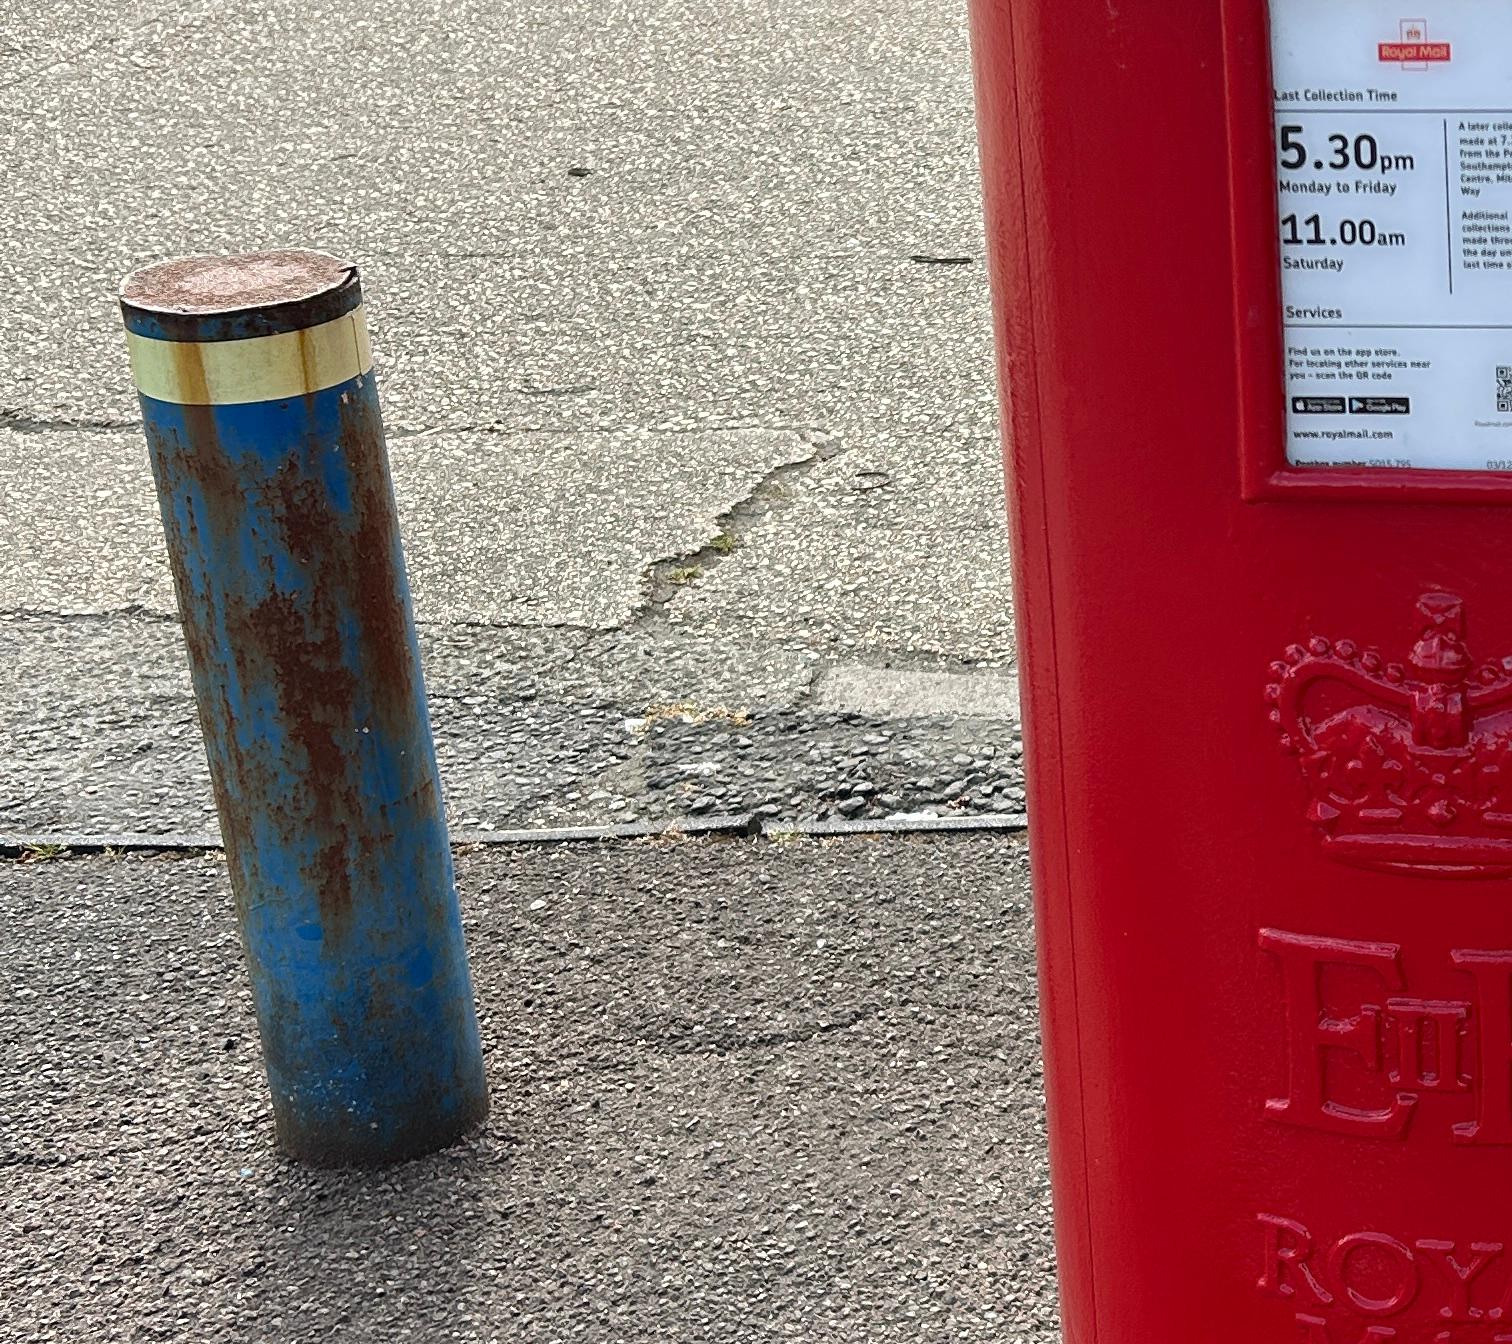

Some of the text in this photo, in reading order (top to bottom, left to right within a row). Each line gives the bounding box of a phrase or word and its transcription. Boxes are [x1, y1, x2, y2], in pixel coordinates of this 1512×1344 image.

[1381, 45, 1447, 61] Royal Mail
[1274, 89, 1397, 102] Last Collection Time
[1459, 121, 1465, 131] A
[1459, 136, 1484, 146] made
[1488, 137, 1497, 146] at
[1280, 125, 1414, 174] 5.30pm
[1459, 149, 1482, 158] from
[1485, 149, 1500, 158] the
[1279, 181, 1397, 197] Monday to Friday
[1460, 186, 1480, 198] Way
[1462, 211, 1508, 220] Additional
[1281, 214, 1406, 246] 11.00am
[1462, 223, 1510, 233] collections
[1463, 236, 1487, 245] made
[1463, 248, 1478, 257] the
[1481, 248, 1497, 258] day
[1283, 257, 1344, 272] Saturday
[1463, 260, 1480, 269] last
[1483, 260, 1504, 269] time
[1286, 306, 1342, 319] Services
[1288, 347, 1307, 356] Find
[1338, 347, 1352, 356] the
[1355, 348, 1371, 358] app
[1289, 359, 1431, 369] For locating other services near
[1339, 371, 1353, 380] the
[1371, 371, 1392, 380] code
[1293, 429, 1393, 441] www.royalmail.com
